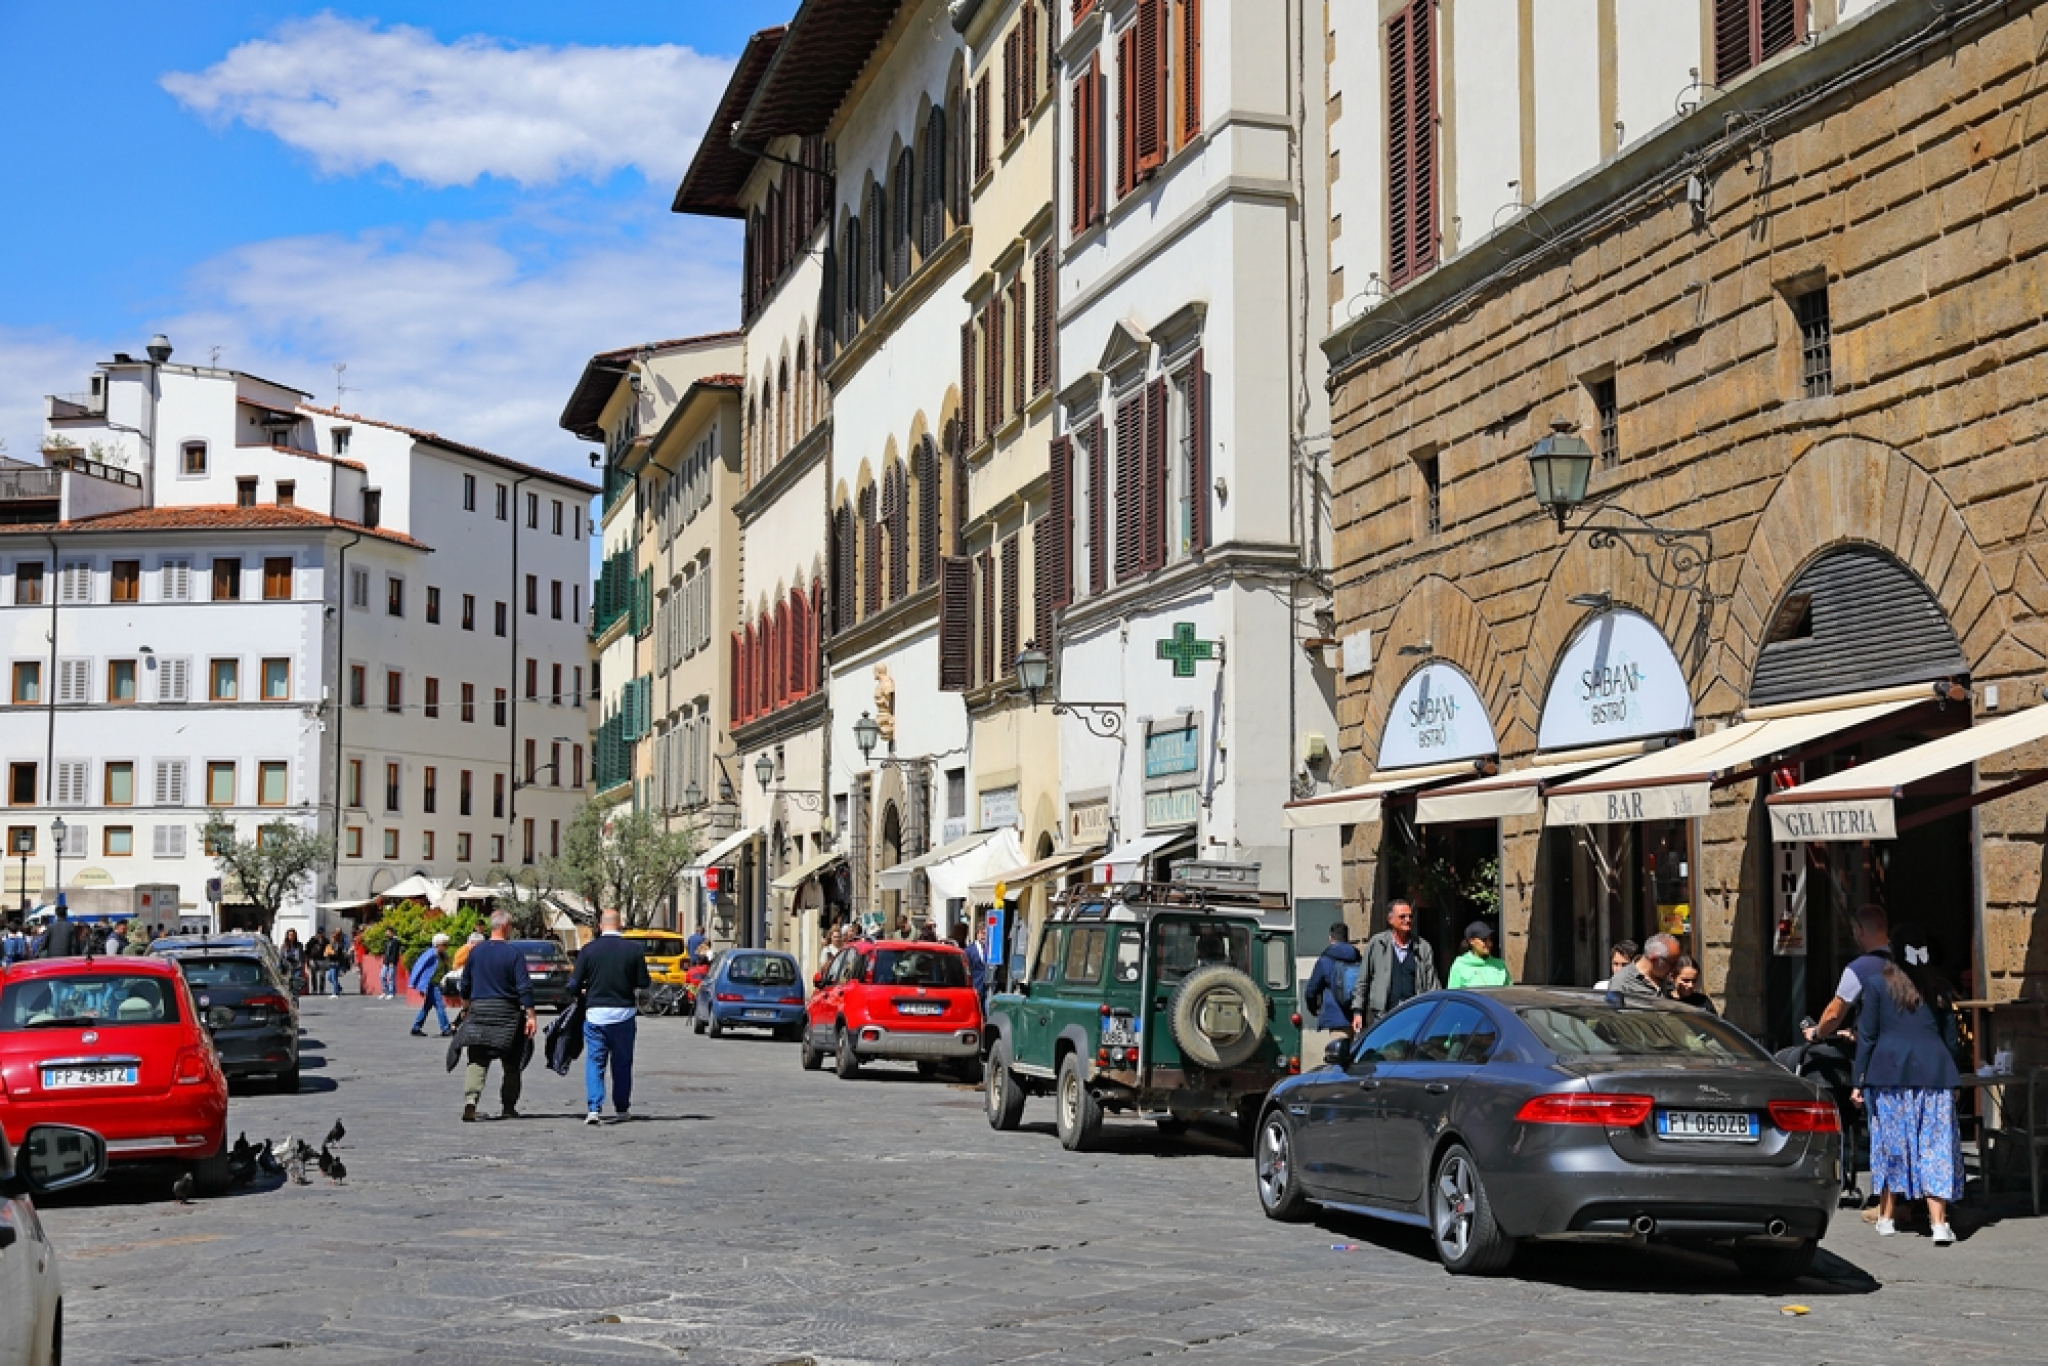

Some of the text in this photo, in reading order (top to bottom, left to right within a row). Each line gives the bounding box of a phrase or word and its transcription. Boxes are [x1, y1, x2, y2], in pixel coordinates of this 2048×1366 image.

[1581, 662, 1638, 700] SABANI
[1409, 694, 1454, 727] SABANI
[1607, 792, 1645, 820] BAR
[1785, 809, 1878, 836] GELATERIA
[55, 1069, 72, 1084] FP
[1668, 1113, 1748, 1133] FY 060ZB
